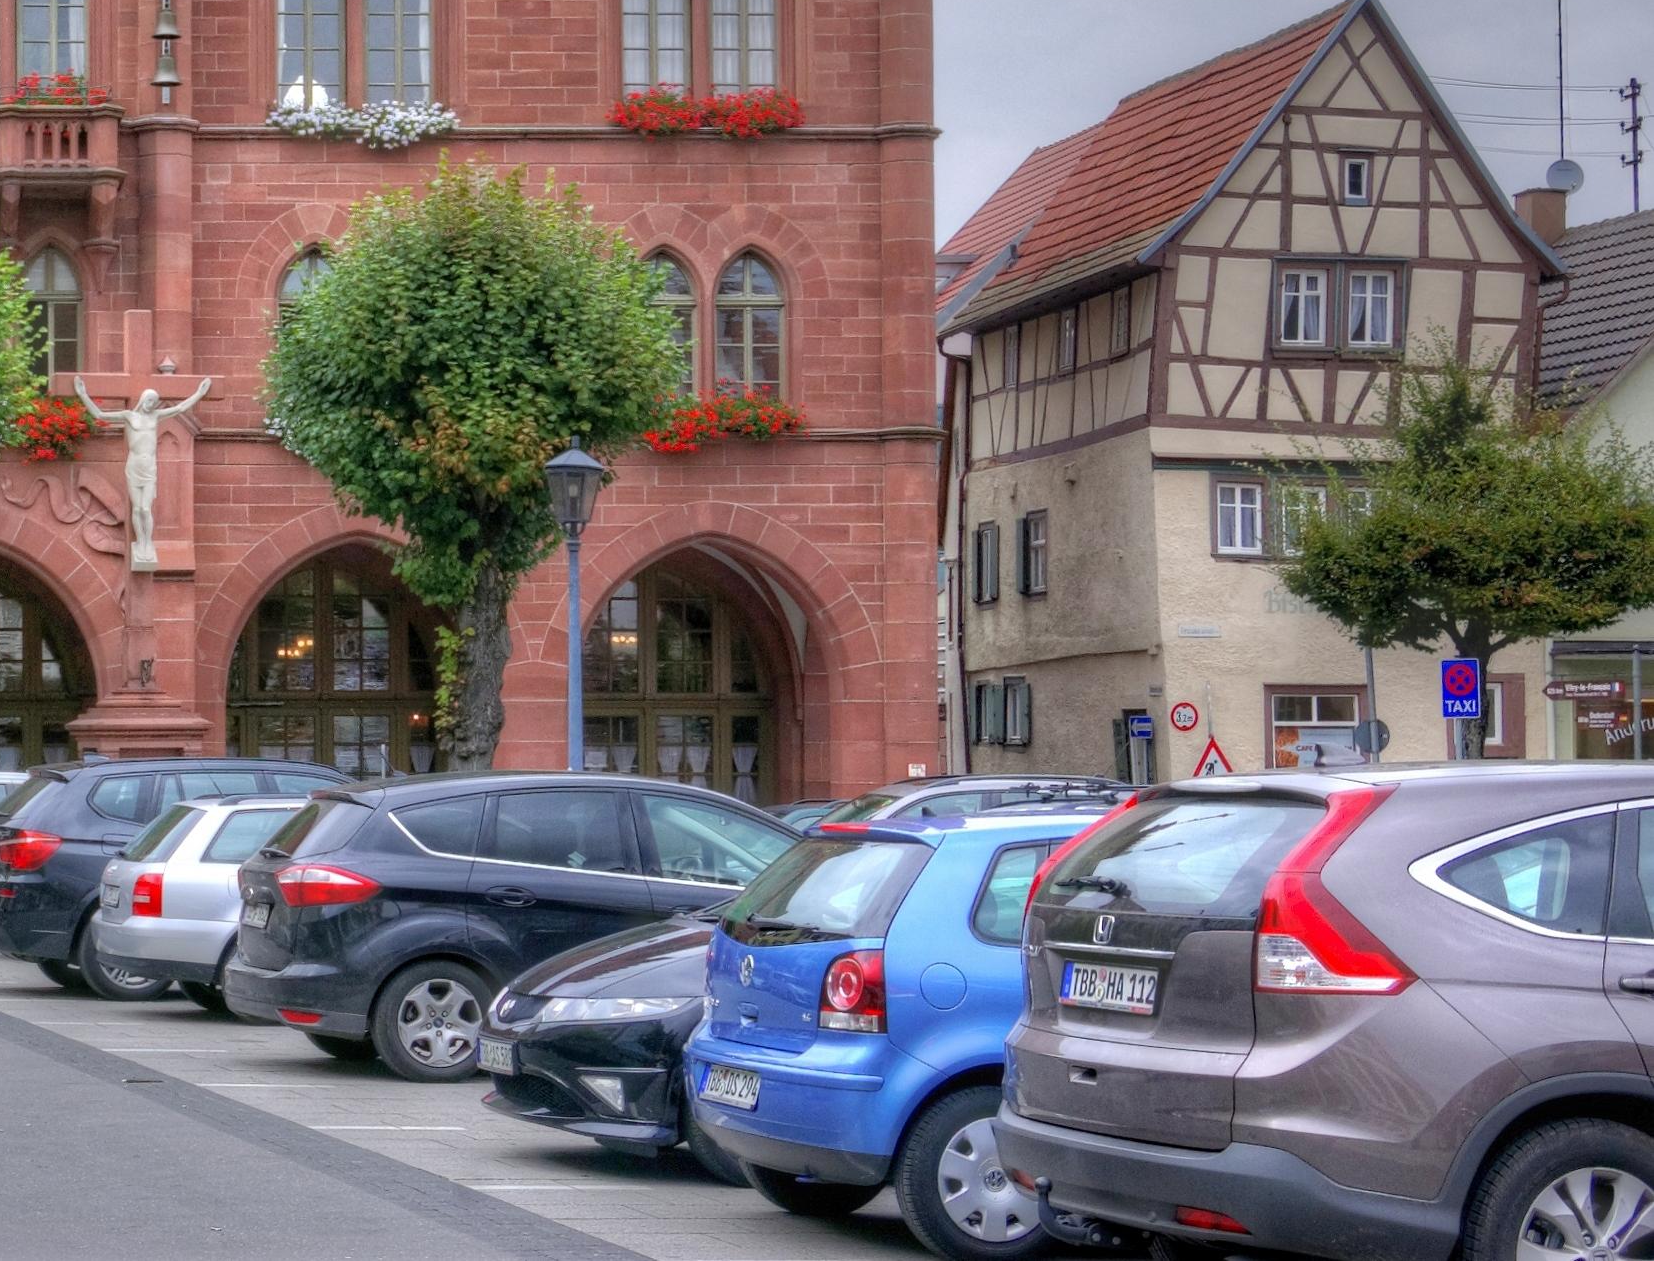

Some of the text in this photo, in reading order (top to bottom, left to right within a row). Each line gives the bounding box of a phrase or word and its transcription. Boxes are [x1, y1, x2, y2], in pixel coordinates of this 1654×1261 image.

[1445, 699, 1476, 713] TAXI
[1074, 968, 1157, 1004] TBB HA 112
